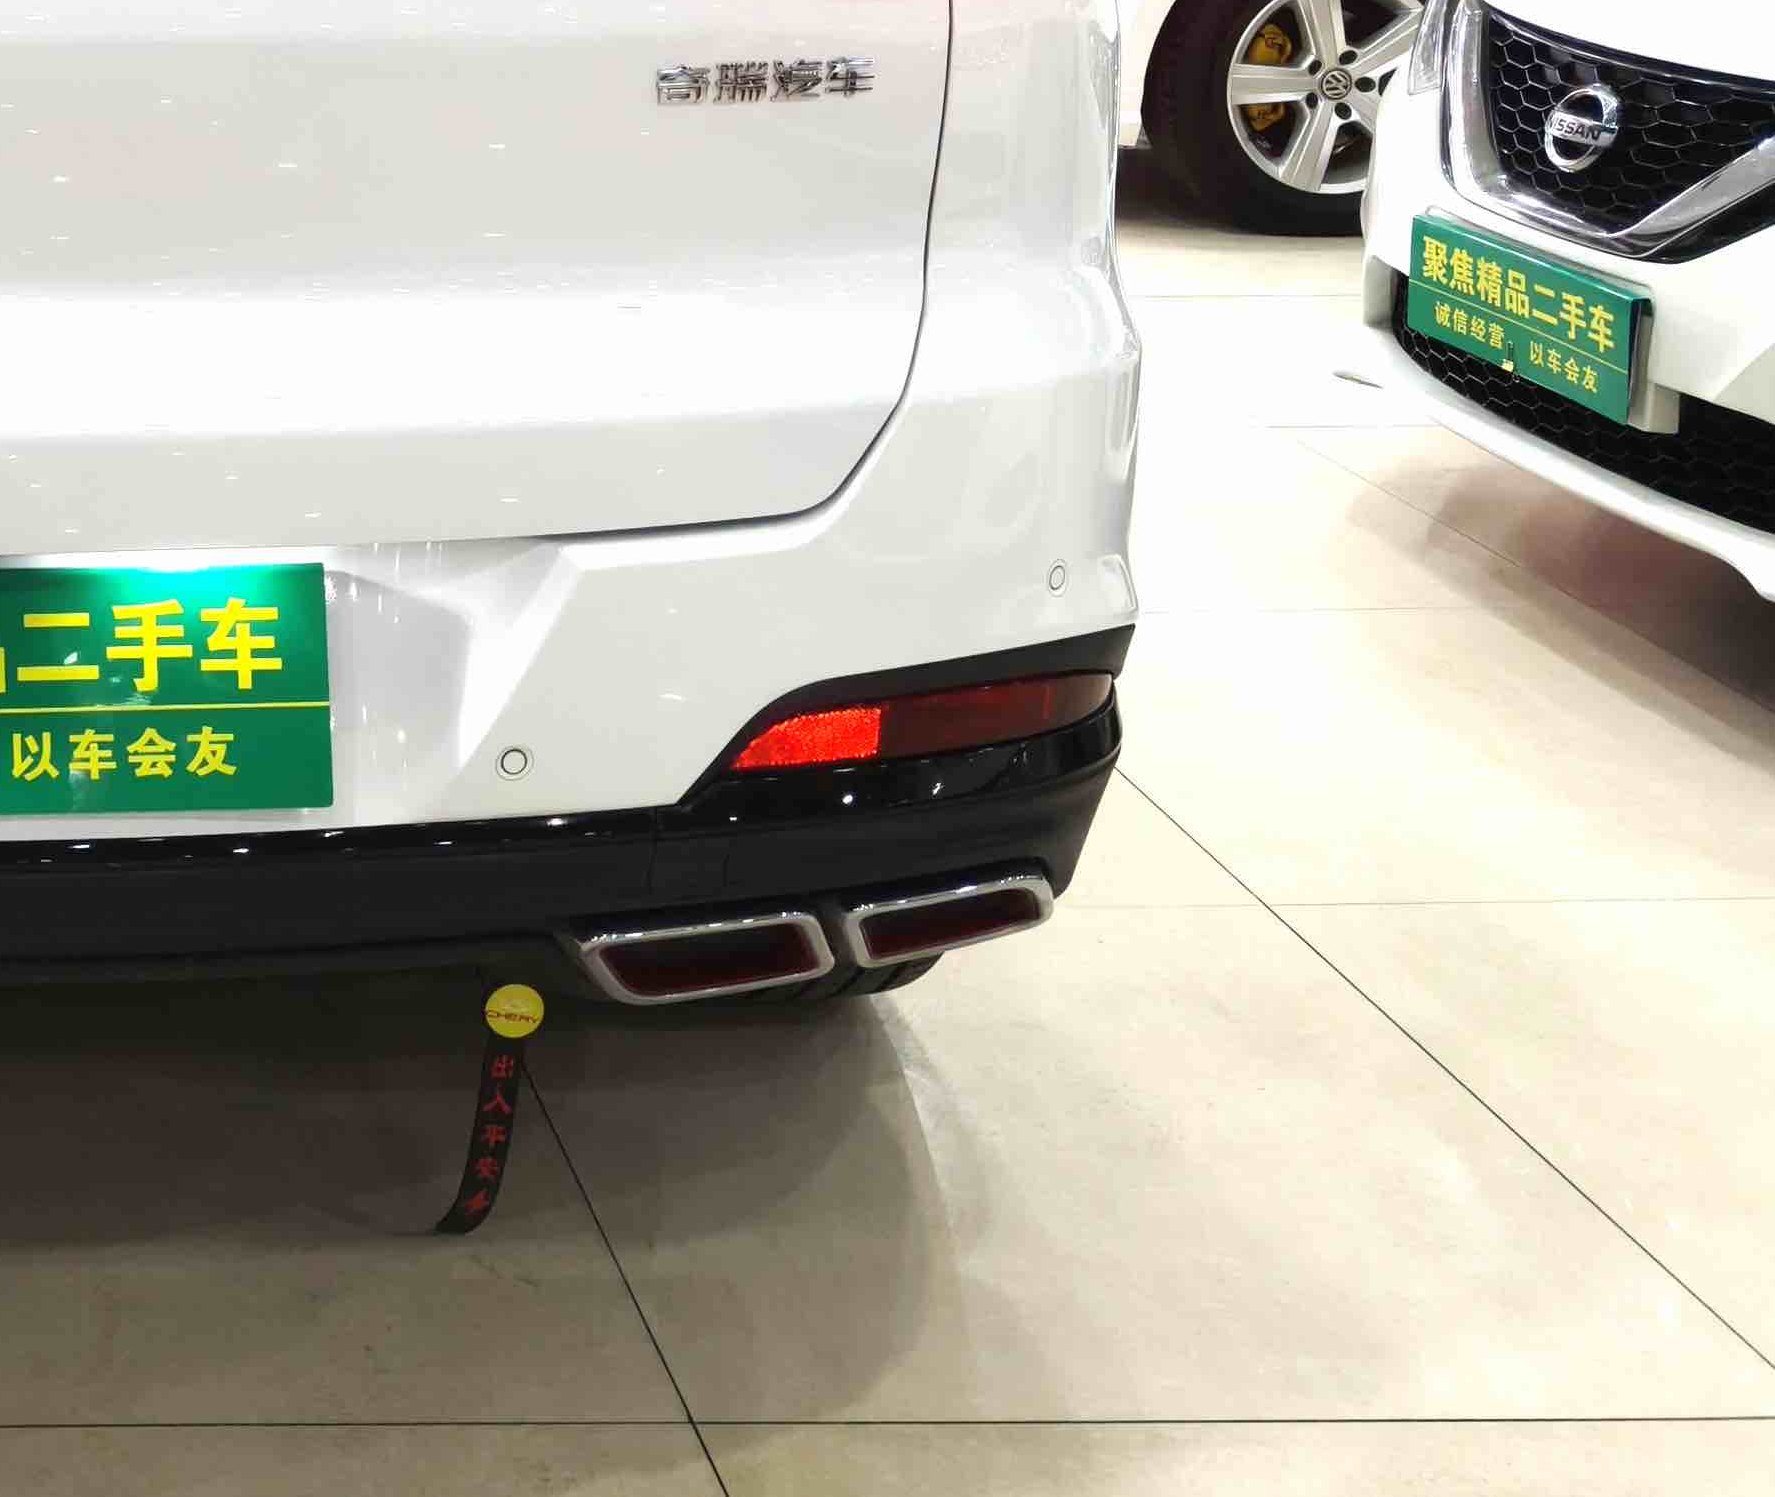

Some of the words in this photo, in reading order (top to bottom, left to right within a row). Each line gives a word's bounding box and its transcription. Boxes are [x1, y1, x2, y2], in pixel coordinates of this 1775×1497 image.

[1422, 236, 1615, 354] 聚焦精品二手车
[10, 725, 238, 781] 以车会友
